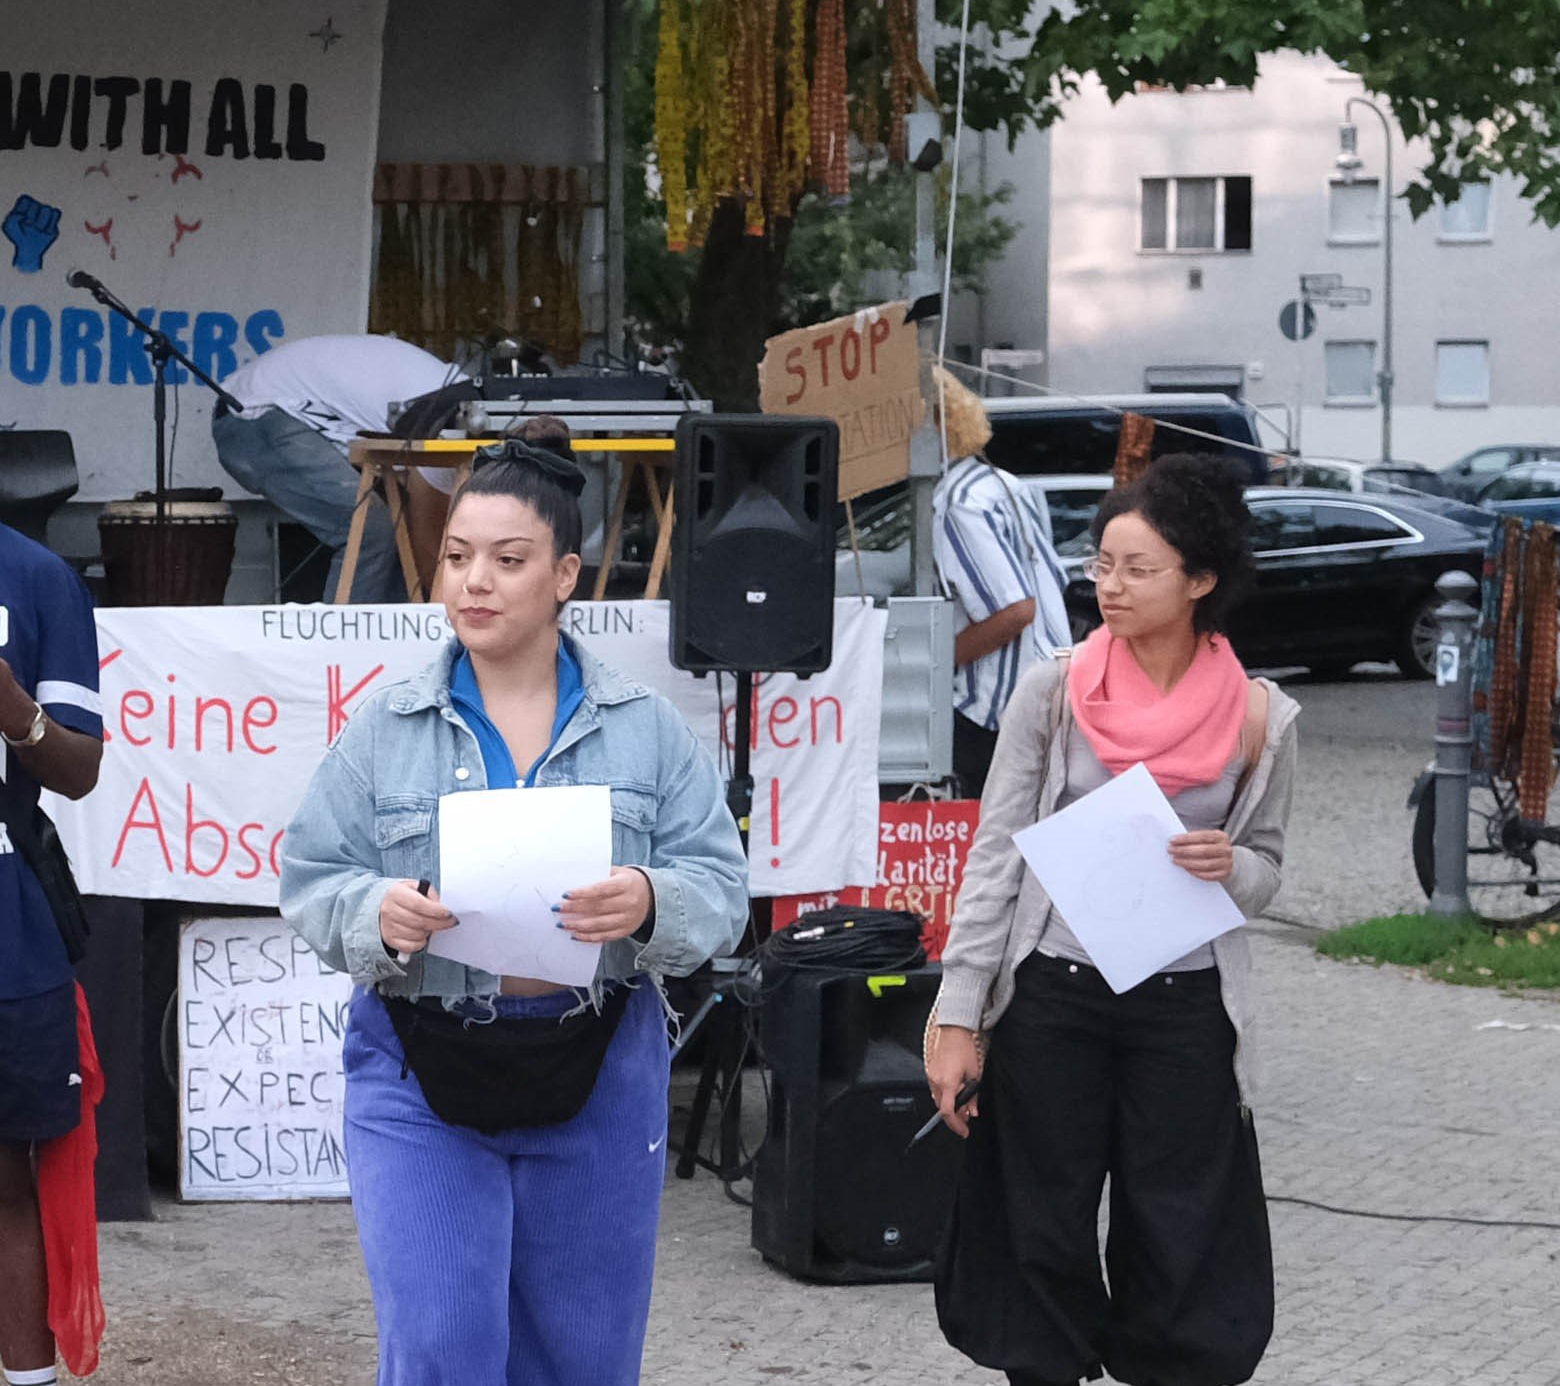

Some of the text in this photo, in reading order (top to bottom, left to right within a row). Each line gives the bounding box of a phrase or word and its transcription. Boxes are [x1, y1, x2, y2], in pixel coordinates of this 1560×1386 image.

[204, 77, 326, 161] ALL
[785, 317, 891, 405] STOP
[187, 1068, 346, 1113] EXPEC
